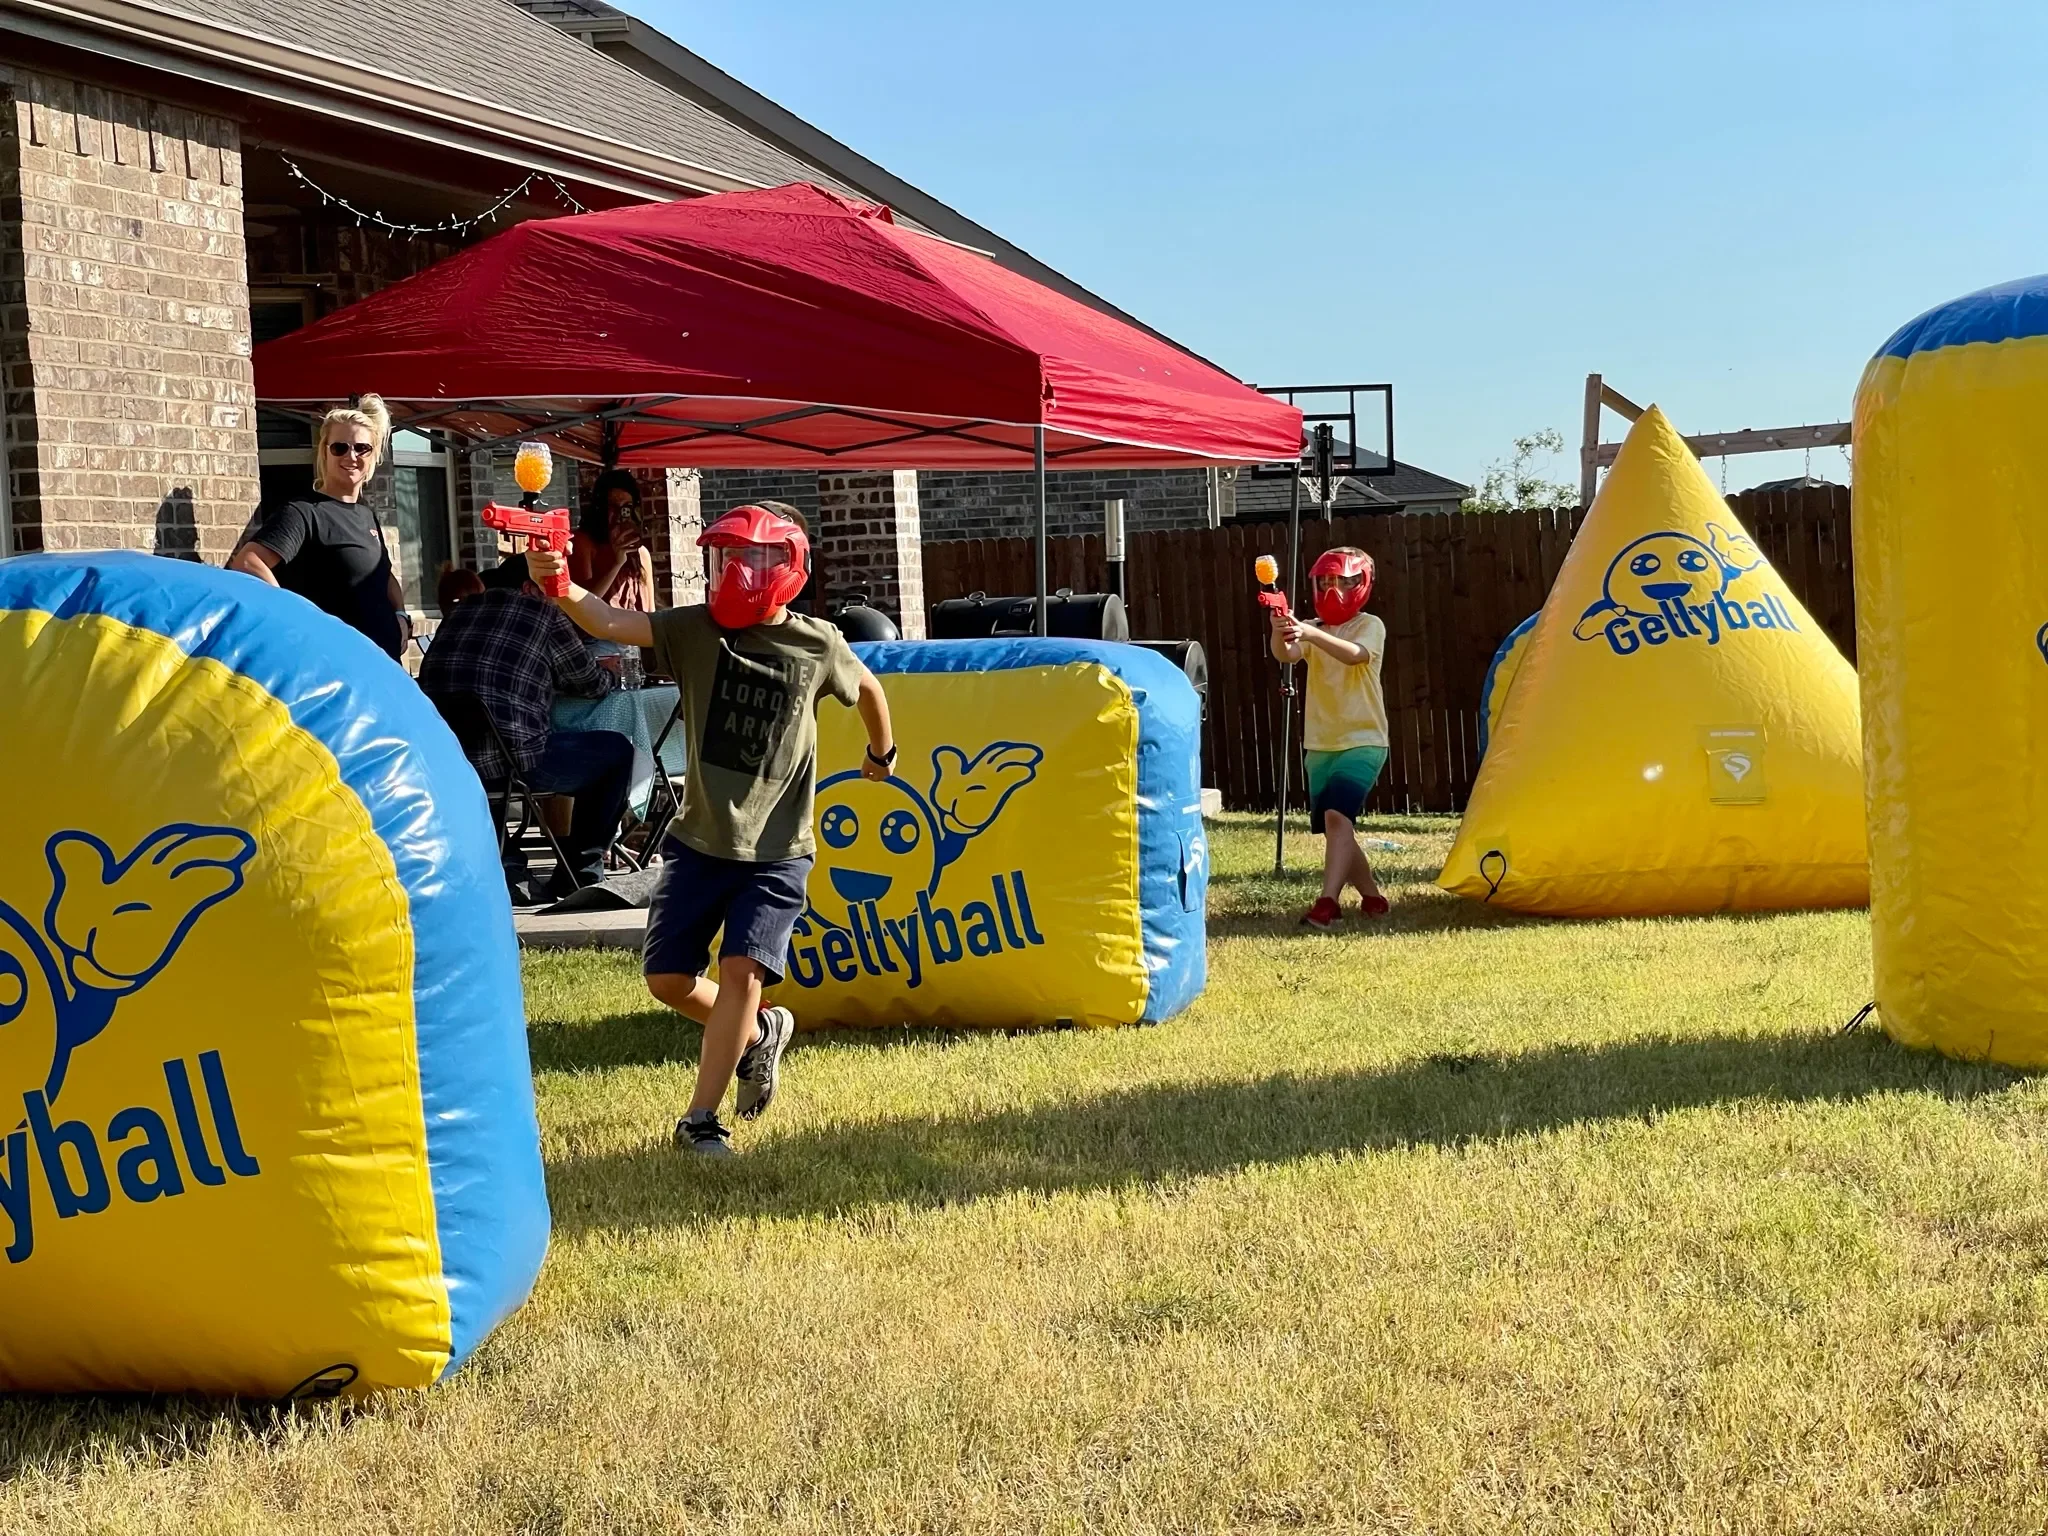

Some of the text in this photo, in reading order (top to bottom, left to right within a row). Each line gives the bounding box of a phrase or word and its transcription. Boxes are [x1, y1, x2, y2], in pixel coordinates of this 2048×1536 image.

[1604, 590, 1802, 655] Gellyball
[724, 711, 784, 741] ARM
[787, 870, 1045, 989] Gellyball
